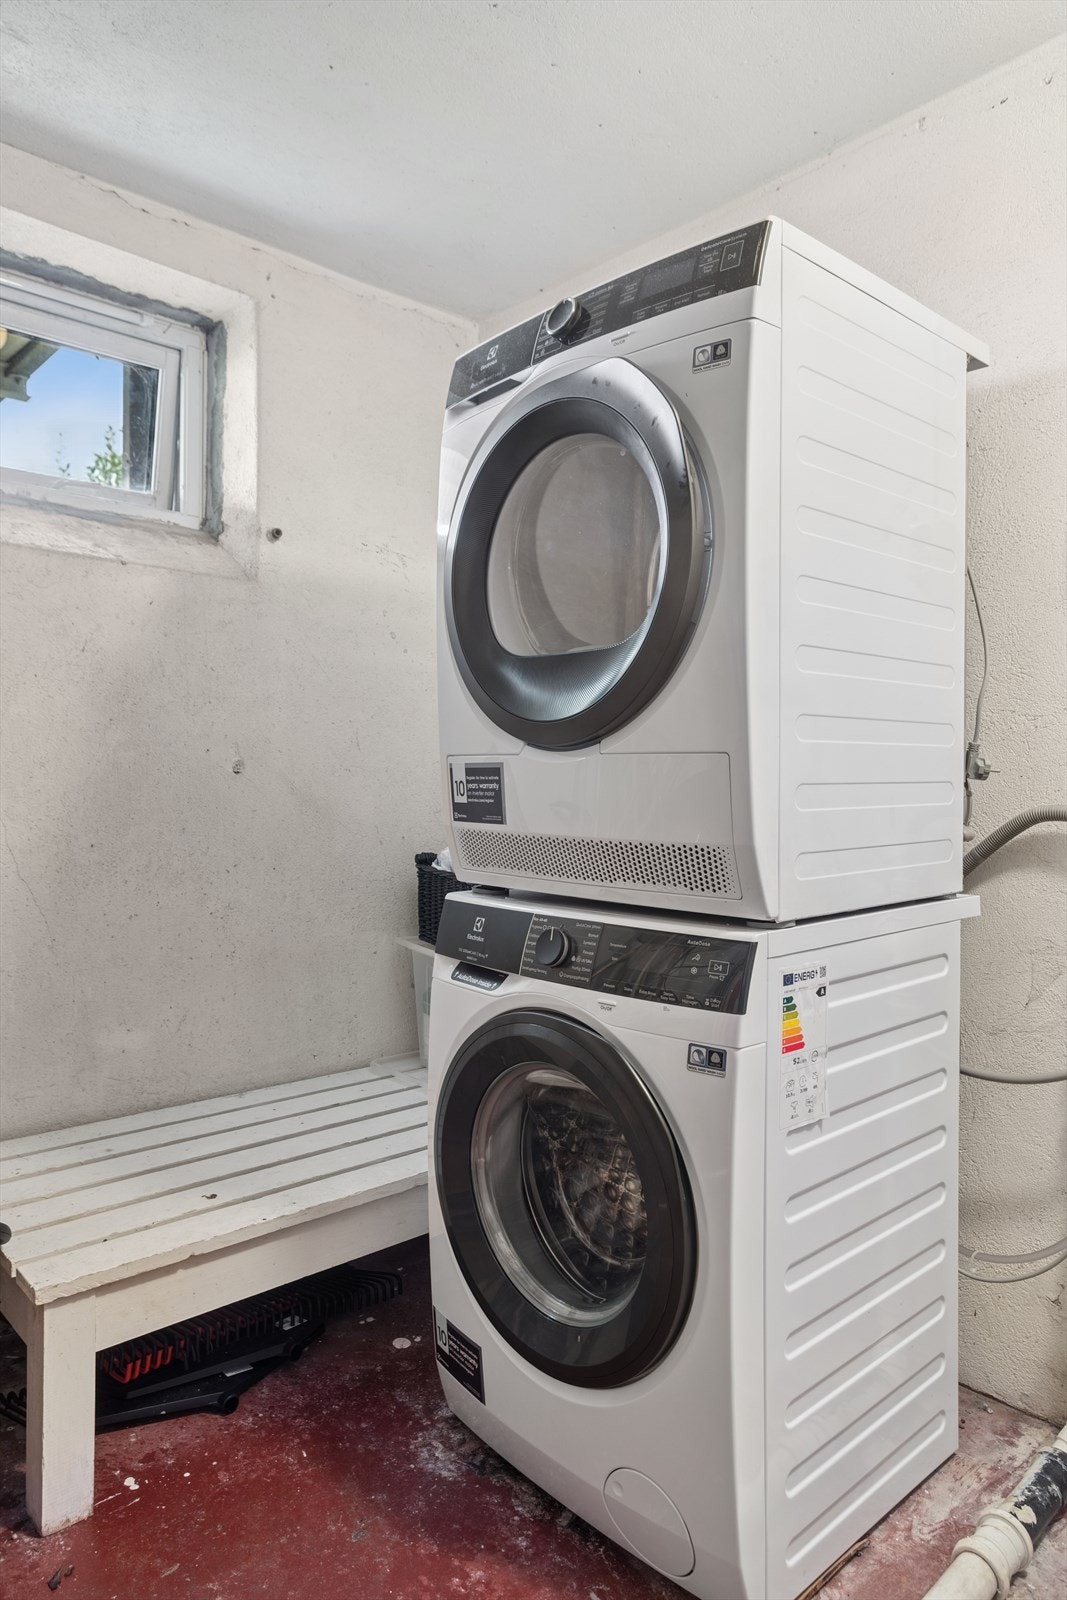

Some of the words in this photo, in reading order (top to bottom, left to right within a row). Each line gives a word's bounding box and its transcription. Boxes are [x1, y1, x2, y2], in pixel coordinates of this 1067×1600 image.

[455, 780, 465, 796] 10
[479, 782, 499, 791] warranty
[467, 933, 485, 942] Electrolux
[687, 939, 711, 947] AutoDose
[794, 969, 815, 983] ENERG
[820, 987, 826, 996] A
[437, 1325, 447, 1347] 10
